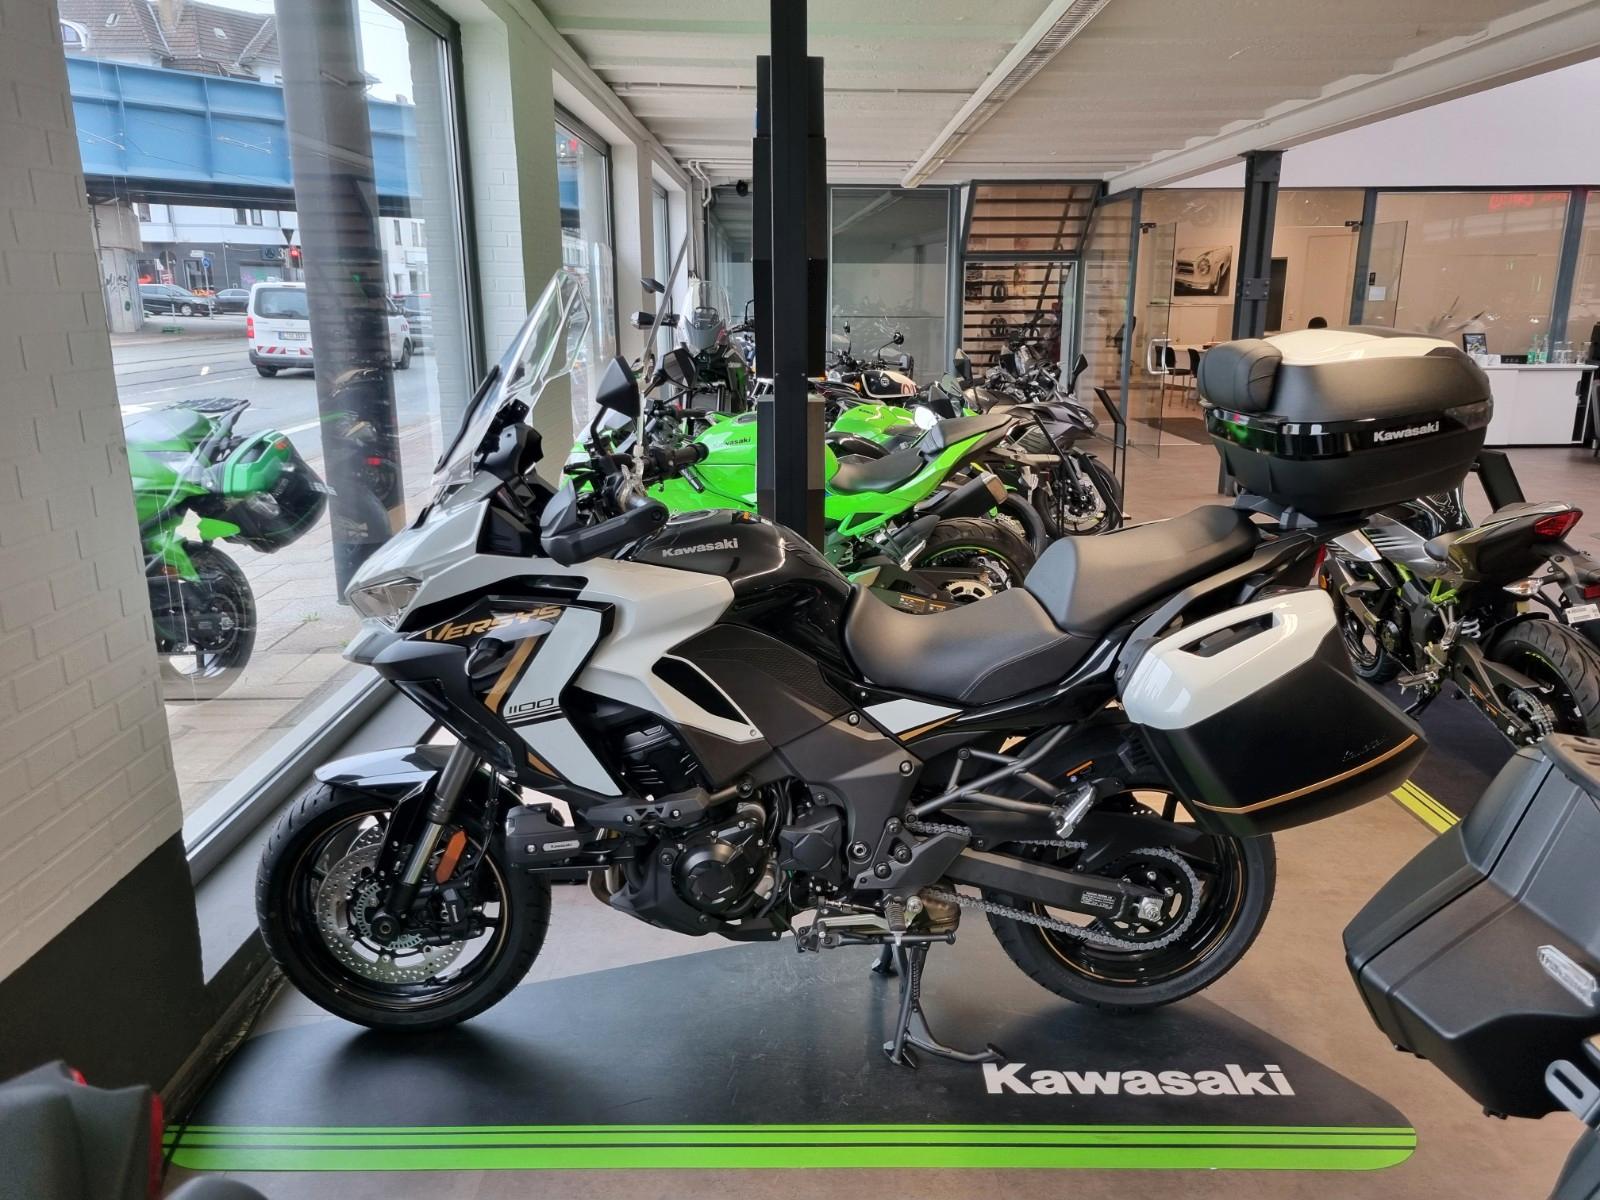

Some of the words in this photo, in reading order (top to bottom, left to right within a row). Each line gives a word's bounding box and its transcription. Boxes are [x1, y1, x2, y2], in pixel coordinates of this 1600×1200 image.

[1374, 421, 1439, 442] Kawasaki
[662, 538, 738, 557] Kawasaki
[426, 606, 561, 641] VERSYS
[509, 698, 554, 714] 1100
[982, 1063, 1295, 1096] Kawasaki
